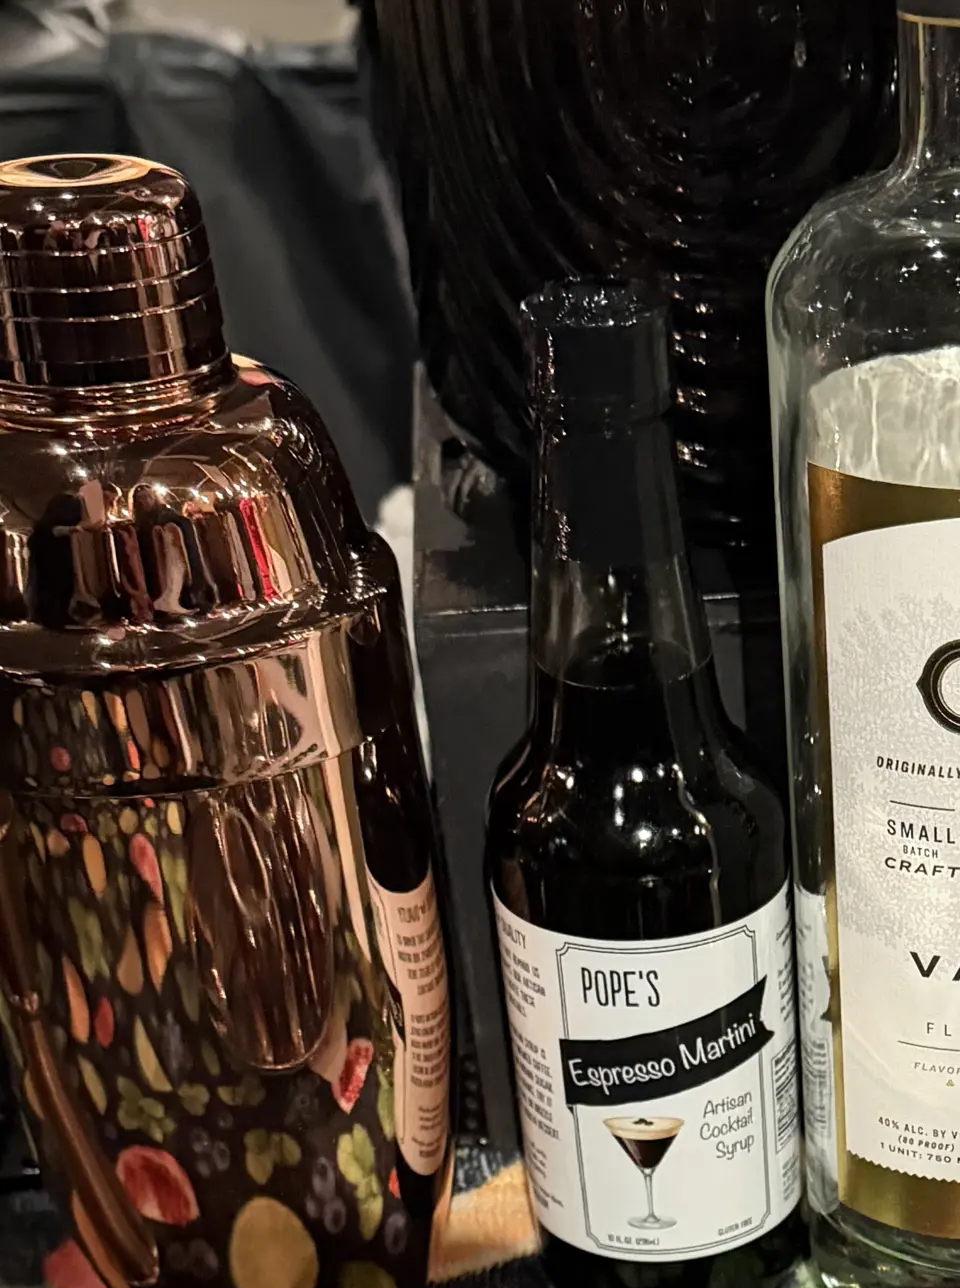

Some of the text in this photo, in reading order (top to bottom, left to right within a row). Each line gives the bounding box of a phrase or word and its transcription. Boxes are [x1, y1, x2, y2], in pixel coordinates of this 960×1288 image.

[887, 819, 956, 844] SMALL
[903, 845, 939, 859] BATCH
[884, 856, 960, 879] CRAFT
[580, 966, 660, 1007] POPE'S
[568, 1057, 676, 1096] Espresso
[679, 1012, 757, 1071] Martini
[945, 1078, 955, 1088] &
[703, 1091, 752, 1119] Artisan
[700, 1107, 754, 1141] Cocktail
[878, 1116, 900, 1130] 40%
[904, 1123, 928, 1137] ALC.
[932, 1128, 946, 1139] BY
[716, 1134, 755, 1160] Syrup
[880, 1141, 885, 1149] 1
[888, 1144, 923, 1159] UNIT:
[898, 1134, 955, 1153] (80 PROOF)
